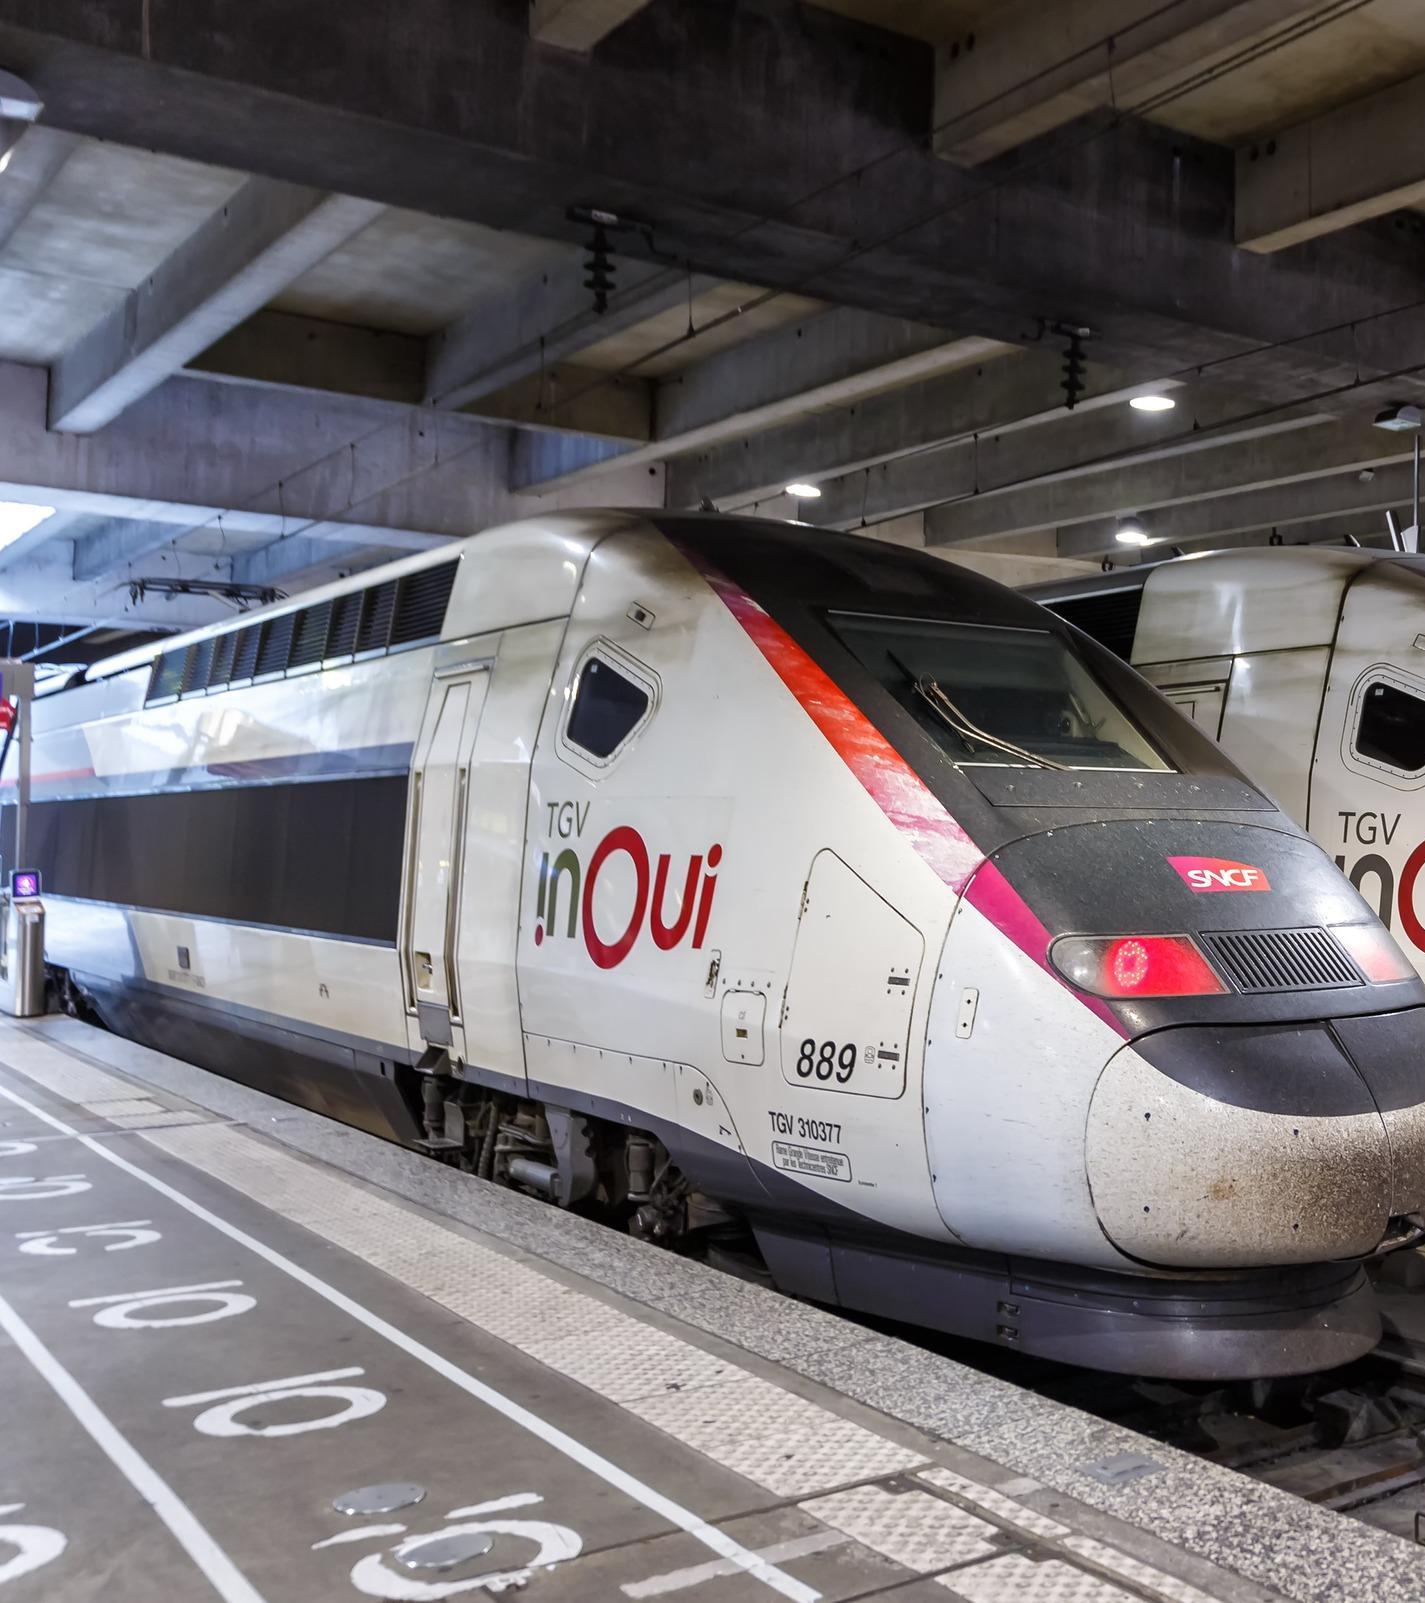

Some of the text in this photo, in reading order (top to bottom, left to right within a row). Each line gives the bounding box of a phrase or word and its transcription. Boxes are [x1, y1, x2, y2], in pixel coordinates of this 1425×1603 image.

[547, 801, 590, 839] TGV
[1338, 811, 1402, 845] TGV
[1187, 869, 1259, 888] SNCF
[796, 1038, 857, 1084] 889
[768, 1110, 841, 1145] TGV 310377
